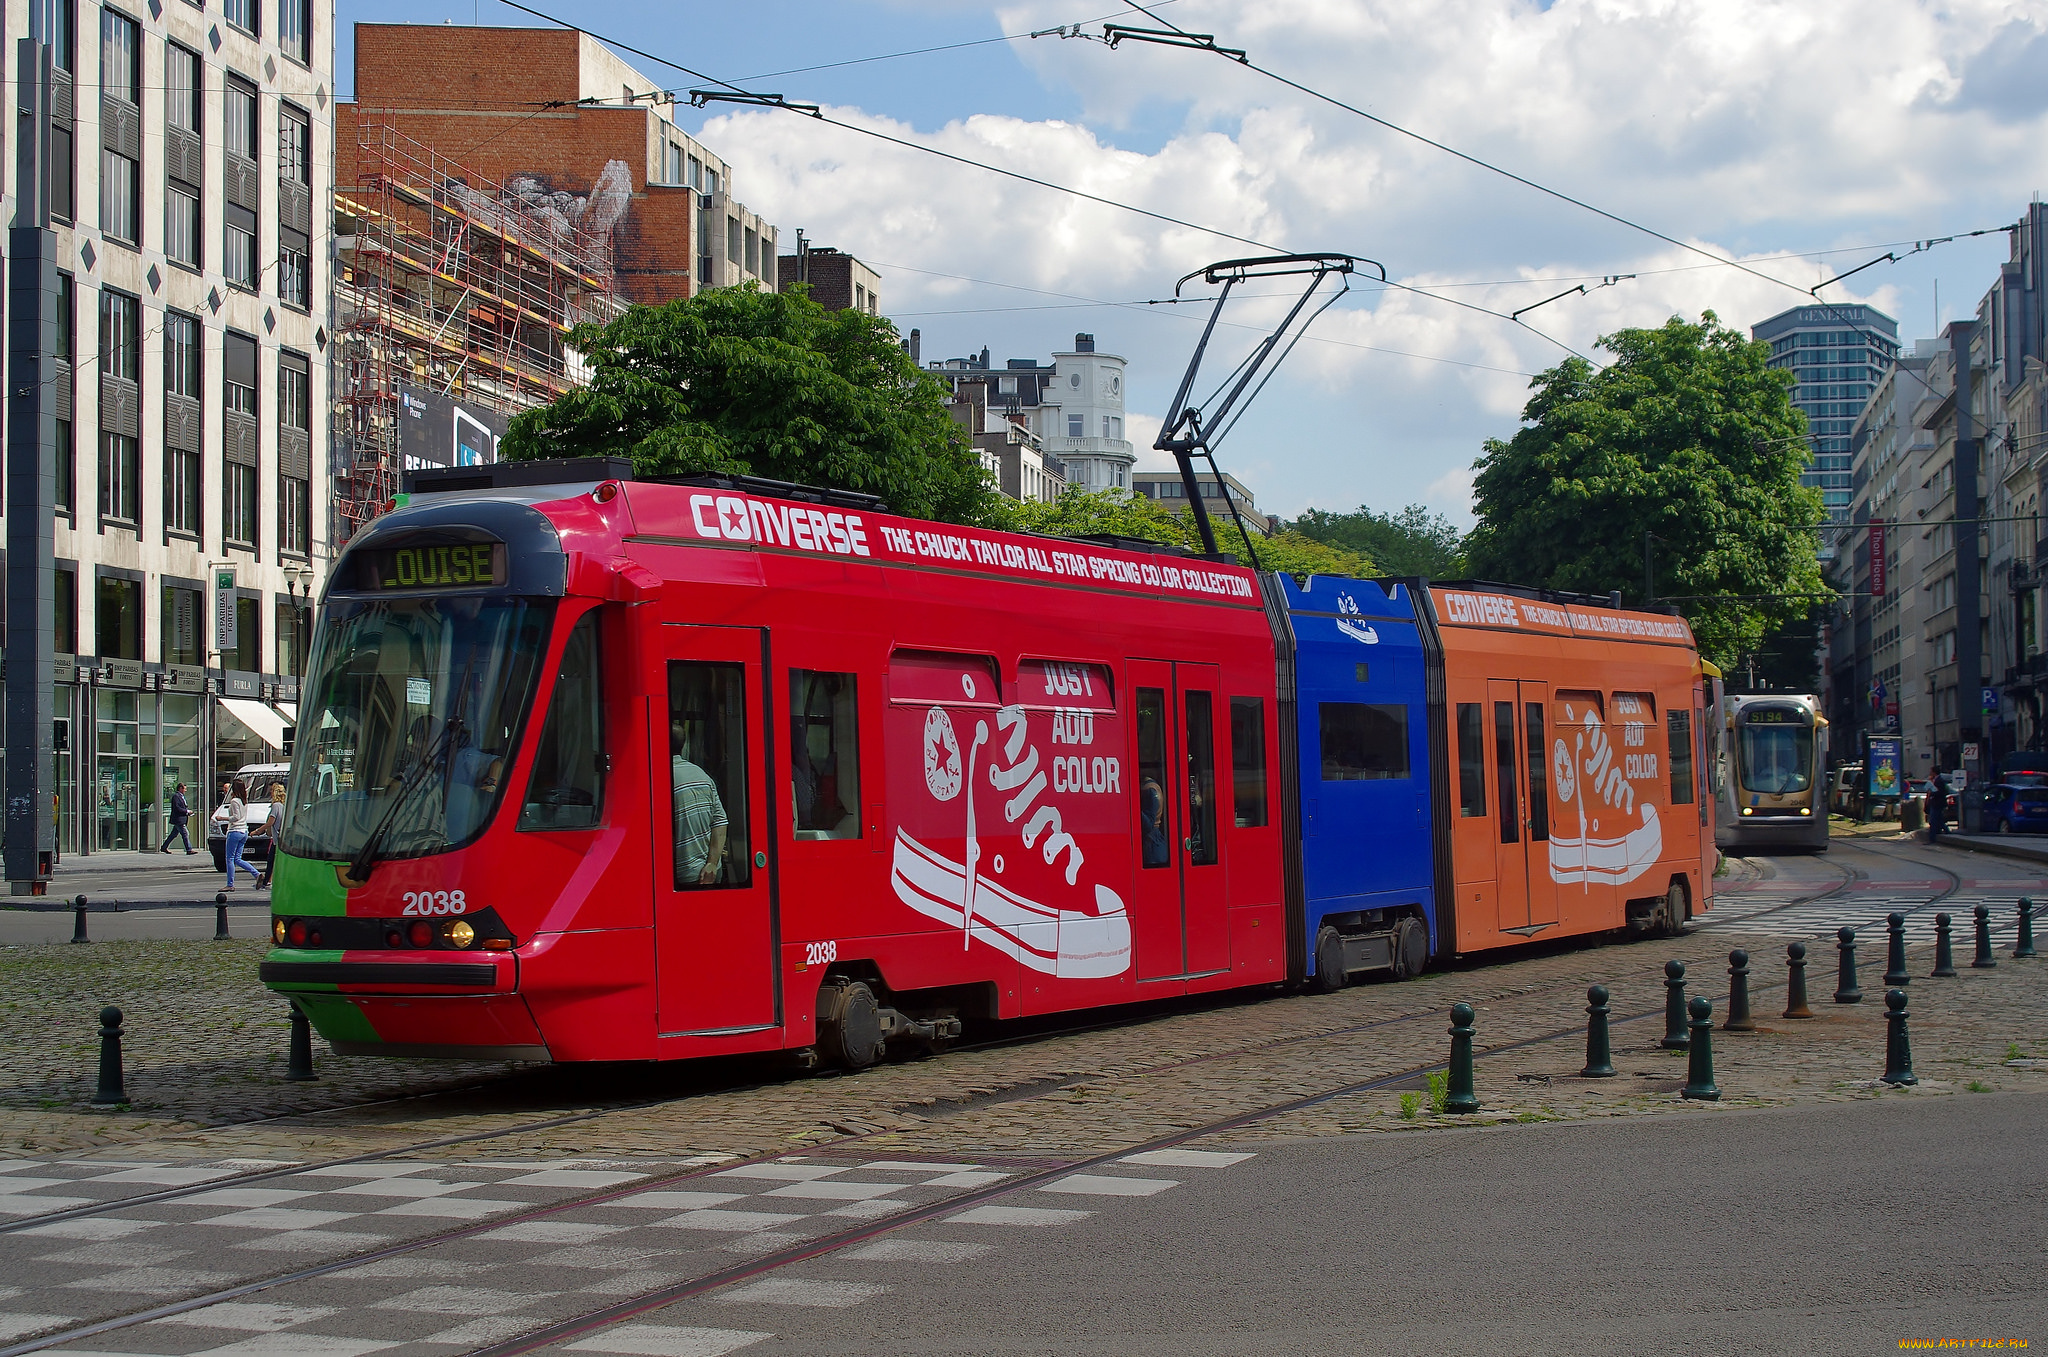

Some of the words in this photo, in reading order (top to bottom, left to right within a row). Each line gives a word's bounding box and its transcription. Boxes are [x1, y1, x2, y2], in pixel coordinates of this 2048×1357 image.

[1799, 308, 1865, 322] GENERALI
[409, 396, 427, 410] Windows
[409, 406, 422, 420] Phone
[689, 494, 870, 557] CONVERSE
[880, 526, 916, 555] THE
[915, 531, 969, 561] CHUCK
[970, 539, 1028, 570] TAYLOR
[1027, 547, 1053, 574] ALL
[1053, 551, 1090, 578] STAR
[1088, 556, 1142, 586] SPRING
[1141, 564, 1183, 590] COLOR
[1181, 569, 1253, 597] COLLECTION
[1873, 529, 1883, 555] Thon
[383, 545, 494, 586] OUISE
[1873, 558, 1883, 591] Hotels
[1444, 593, 1520, 626] CONVERSE
[1521, 604, 1539, 623] THE
[1537, 607, 1564, 627] CHUCK
[1589, 614, 1603, 632] ALL
[1601, 616, 1620, 633] STAR
[1618, 618, 1646, 636] SPRING
[1644, 621, 1666, 637] COLOR
[233, 679, 252, 690] FURLA
[1043, 662, 1093, 696] JUST
[1617, 695, 1642, 714] JUST
[1052, 706, 1094, 745] ADD
[1624, 720, 1645, 747] ADD
[1964, 746, 1977, 757] 27
[1053, 756, 1121, 794] COLOR
[1625, 754, 1659, 779] COLOR
[402, 889, 466, 916] 2038
[805, 940, 837, 965] 2038
